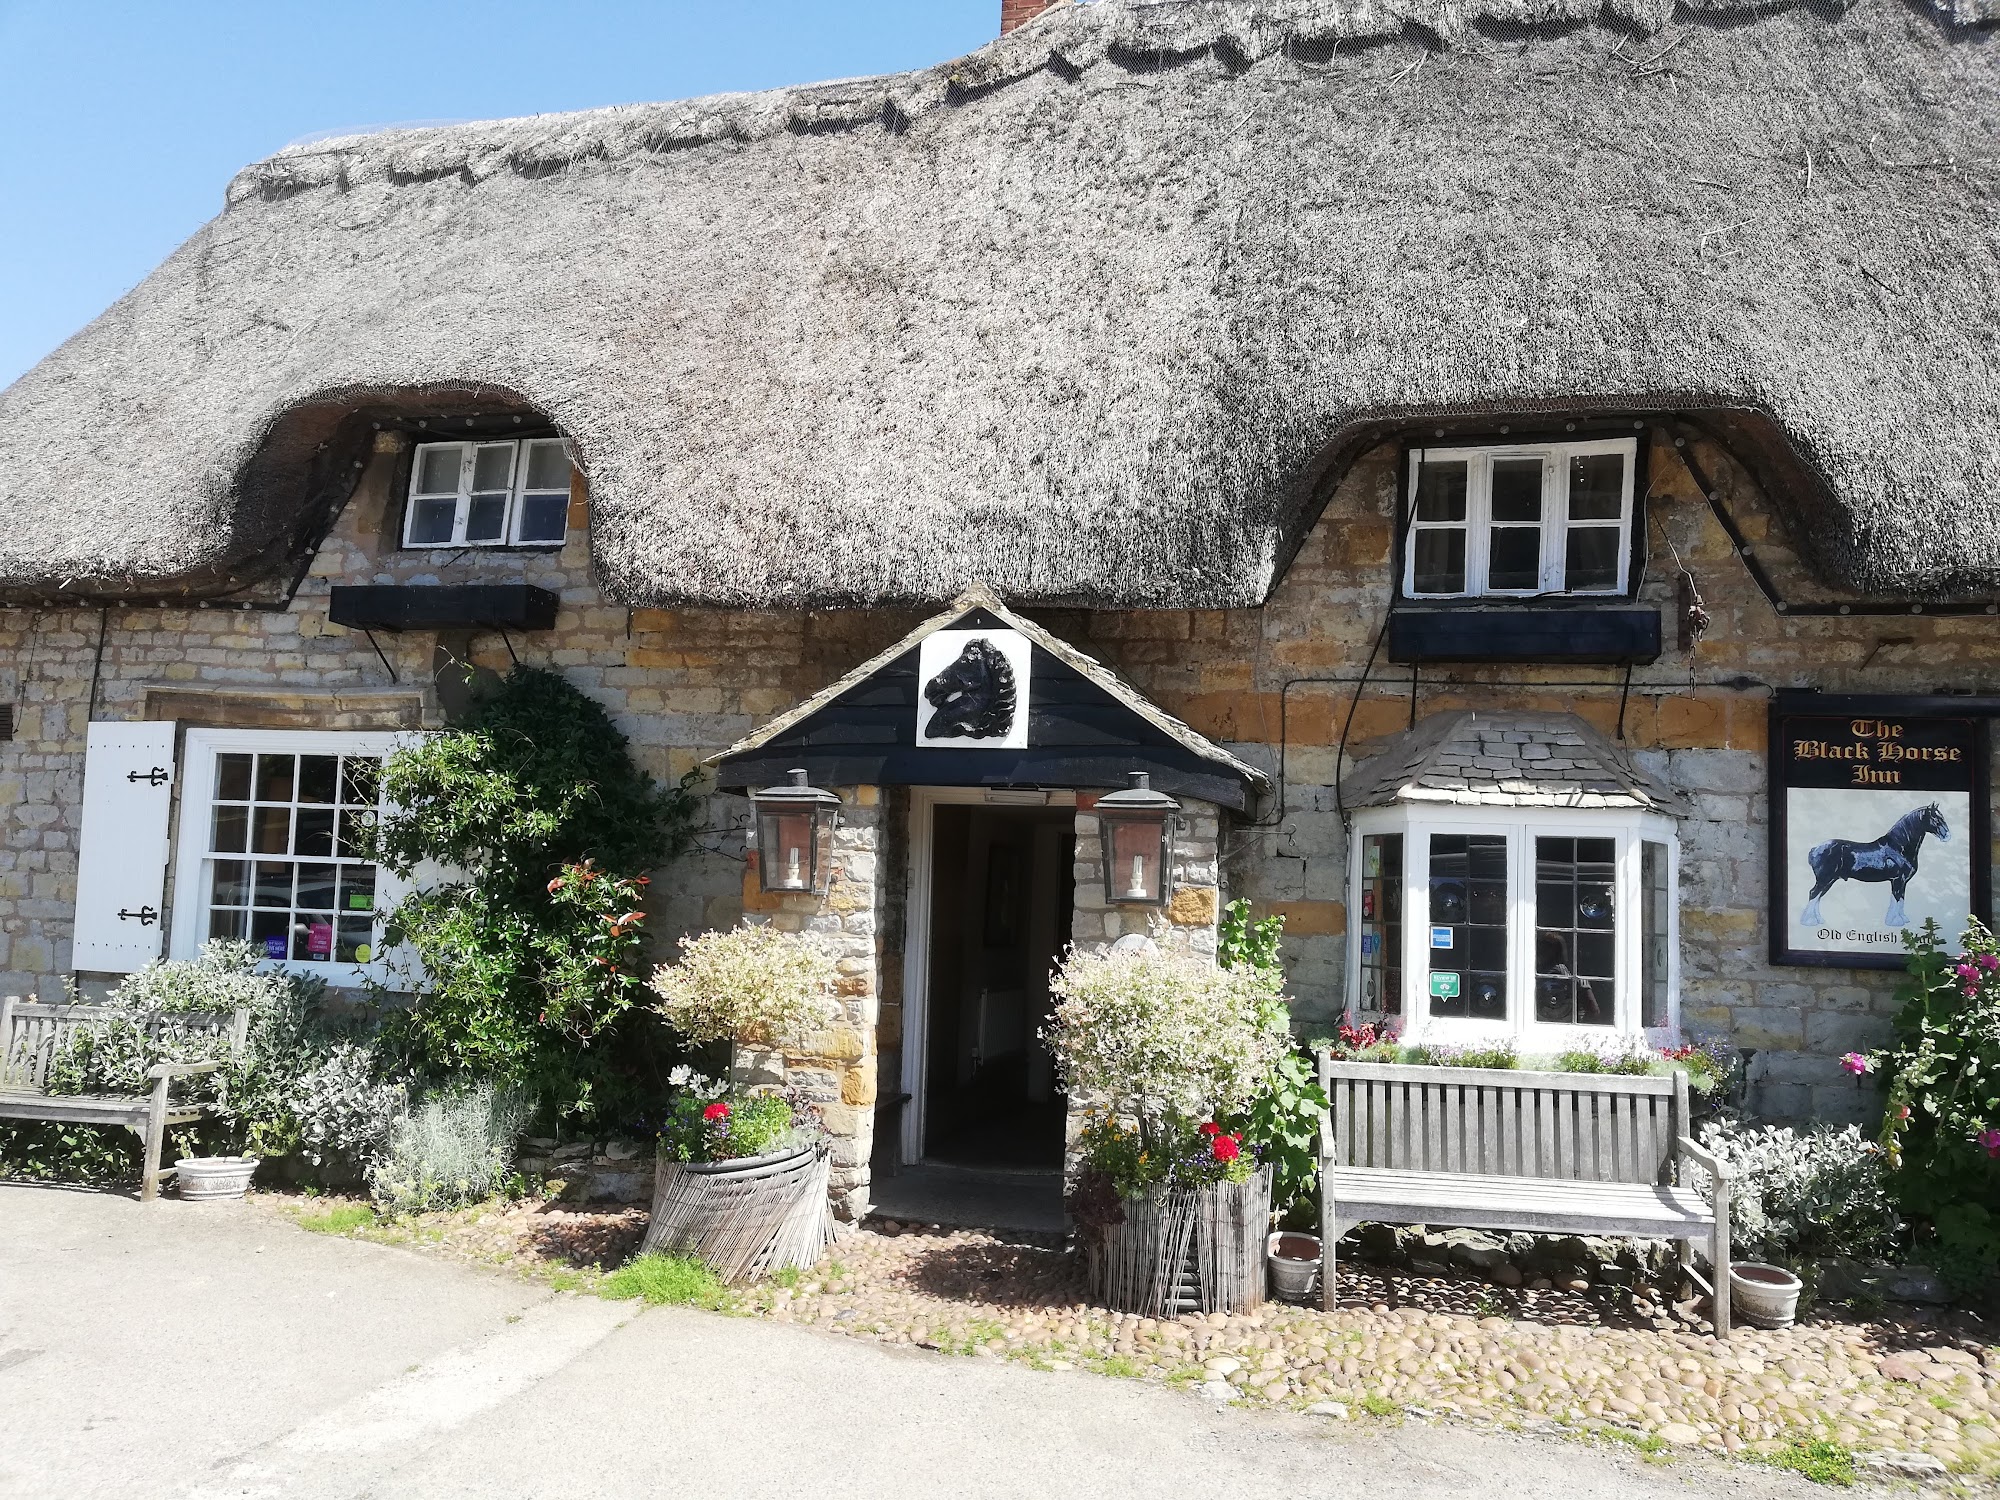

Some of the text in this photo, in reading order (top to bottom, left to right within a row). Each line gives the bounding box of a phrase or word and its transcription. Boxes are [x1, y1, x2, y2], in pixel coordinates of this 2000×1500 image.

[1851, 719, 1904, 740] The
[1793, 740, 1963, 762] Black Horse
[1851, 764, 1902, 784] Inn
[1817, 928, 1842, 940] Old
[1845, 930, 1898, 944] English
